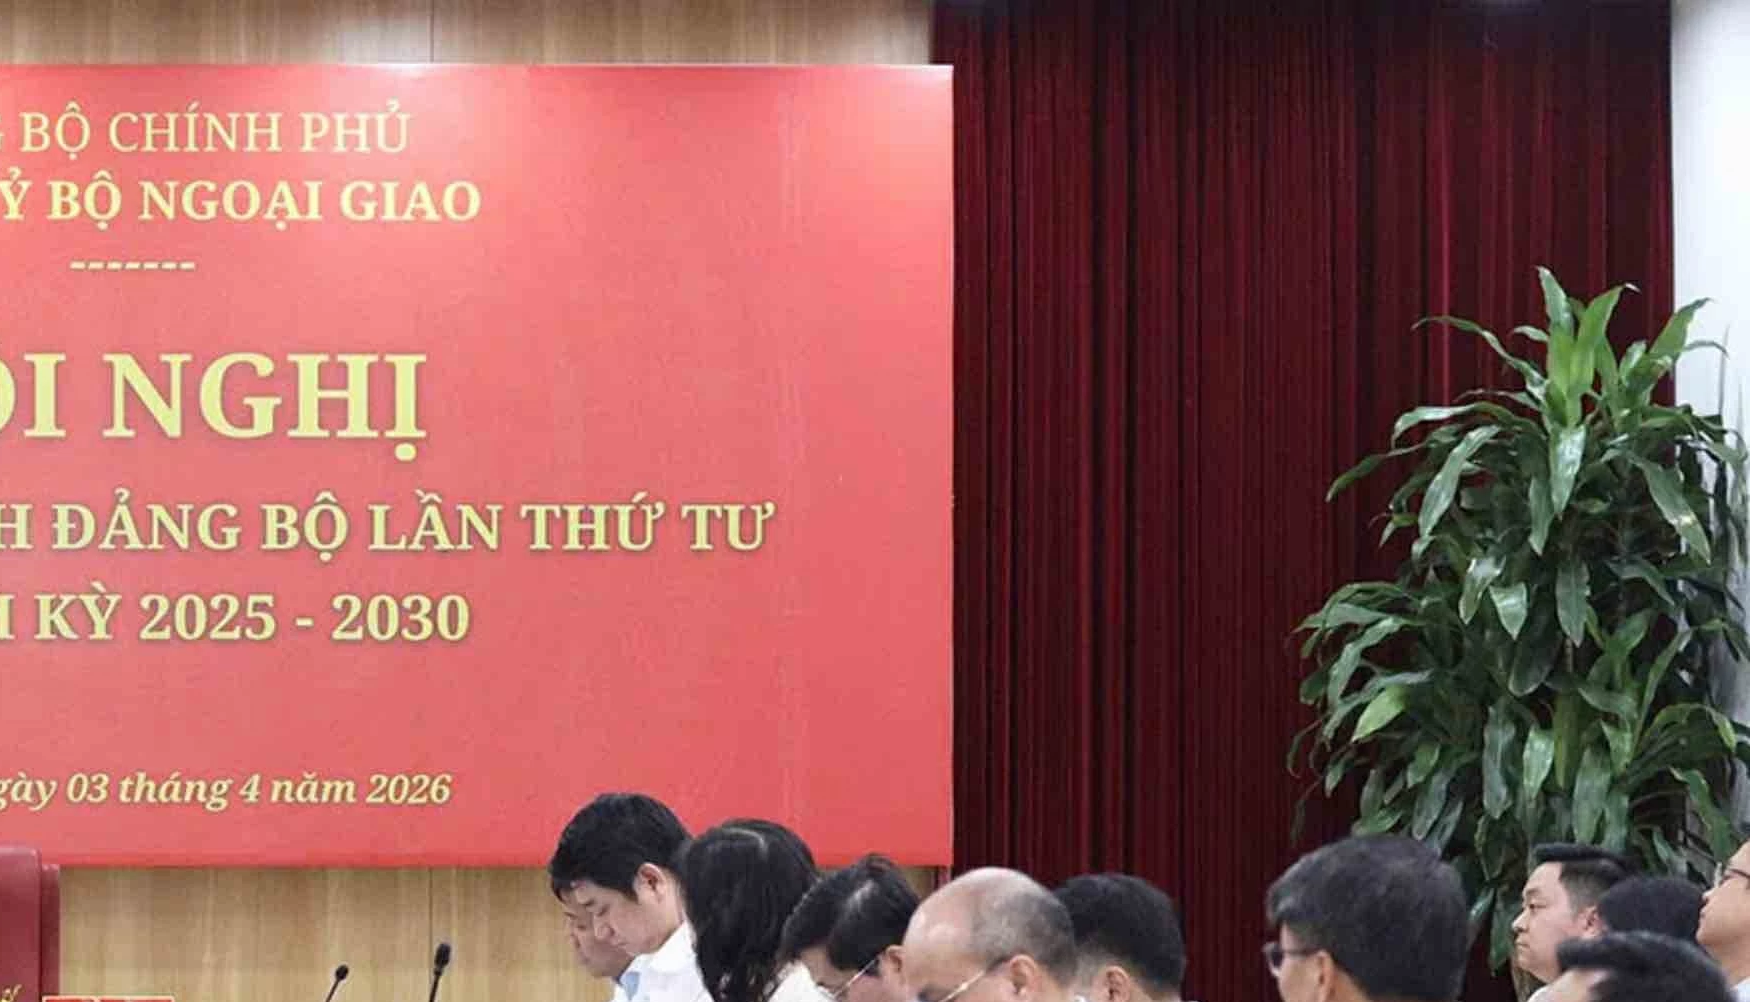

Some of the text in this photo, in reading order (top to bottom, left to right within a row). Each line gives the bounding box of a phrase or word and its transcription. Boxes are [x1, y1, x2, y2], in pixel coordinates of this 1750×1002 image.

[19, 103, 91, 160] BỘ
[107, 102, 282, 154] CHÍNH
[300, 98, 410, 153] PHỦ
[47, 170, 123, 230] BỘ
[139, 179, 323, 229] NGOẠI
[340, 179, 482, 222] GIAO
[105, 351, 427, 463] NGHỊ
[55, 489, 240, 553] ĐẢNG
[263, 492, 348, 561] BỘ
[370, 490, 503, 553] LẦN
[521, 492, 668, 553] THỨ
[682, 500, 778, 552] TƯ
[37, 582, 122, 641] KỲ
[140, 591, 278, 642] 2025
[296, 616, 315, 626] -
[330, 592, 472, 642] 2030
[65, 773, 110, 804] 03
[118, 773, 232, 812] tháng
[240, 773, 262, 804] 4
[270, 774, 357, 804] năm
[366, 772, 453, 805] 2026
